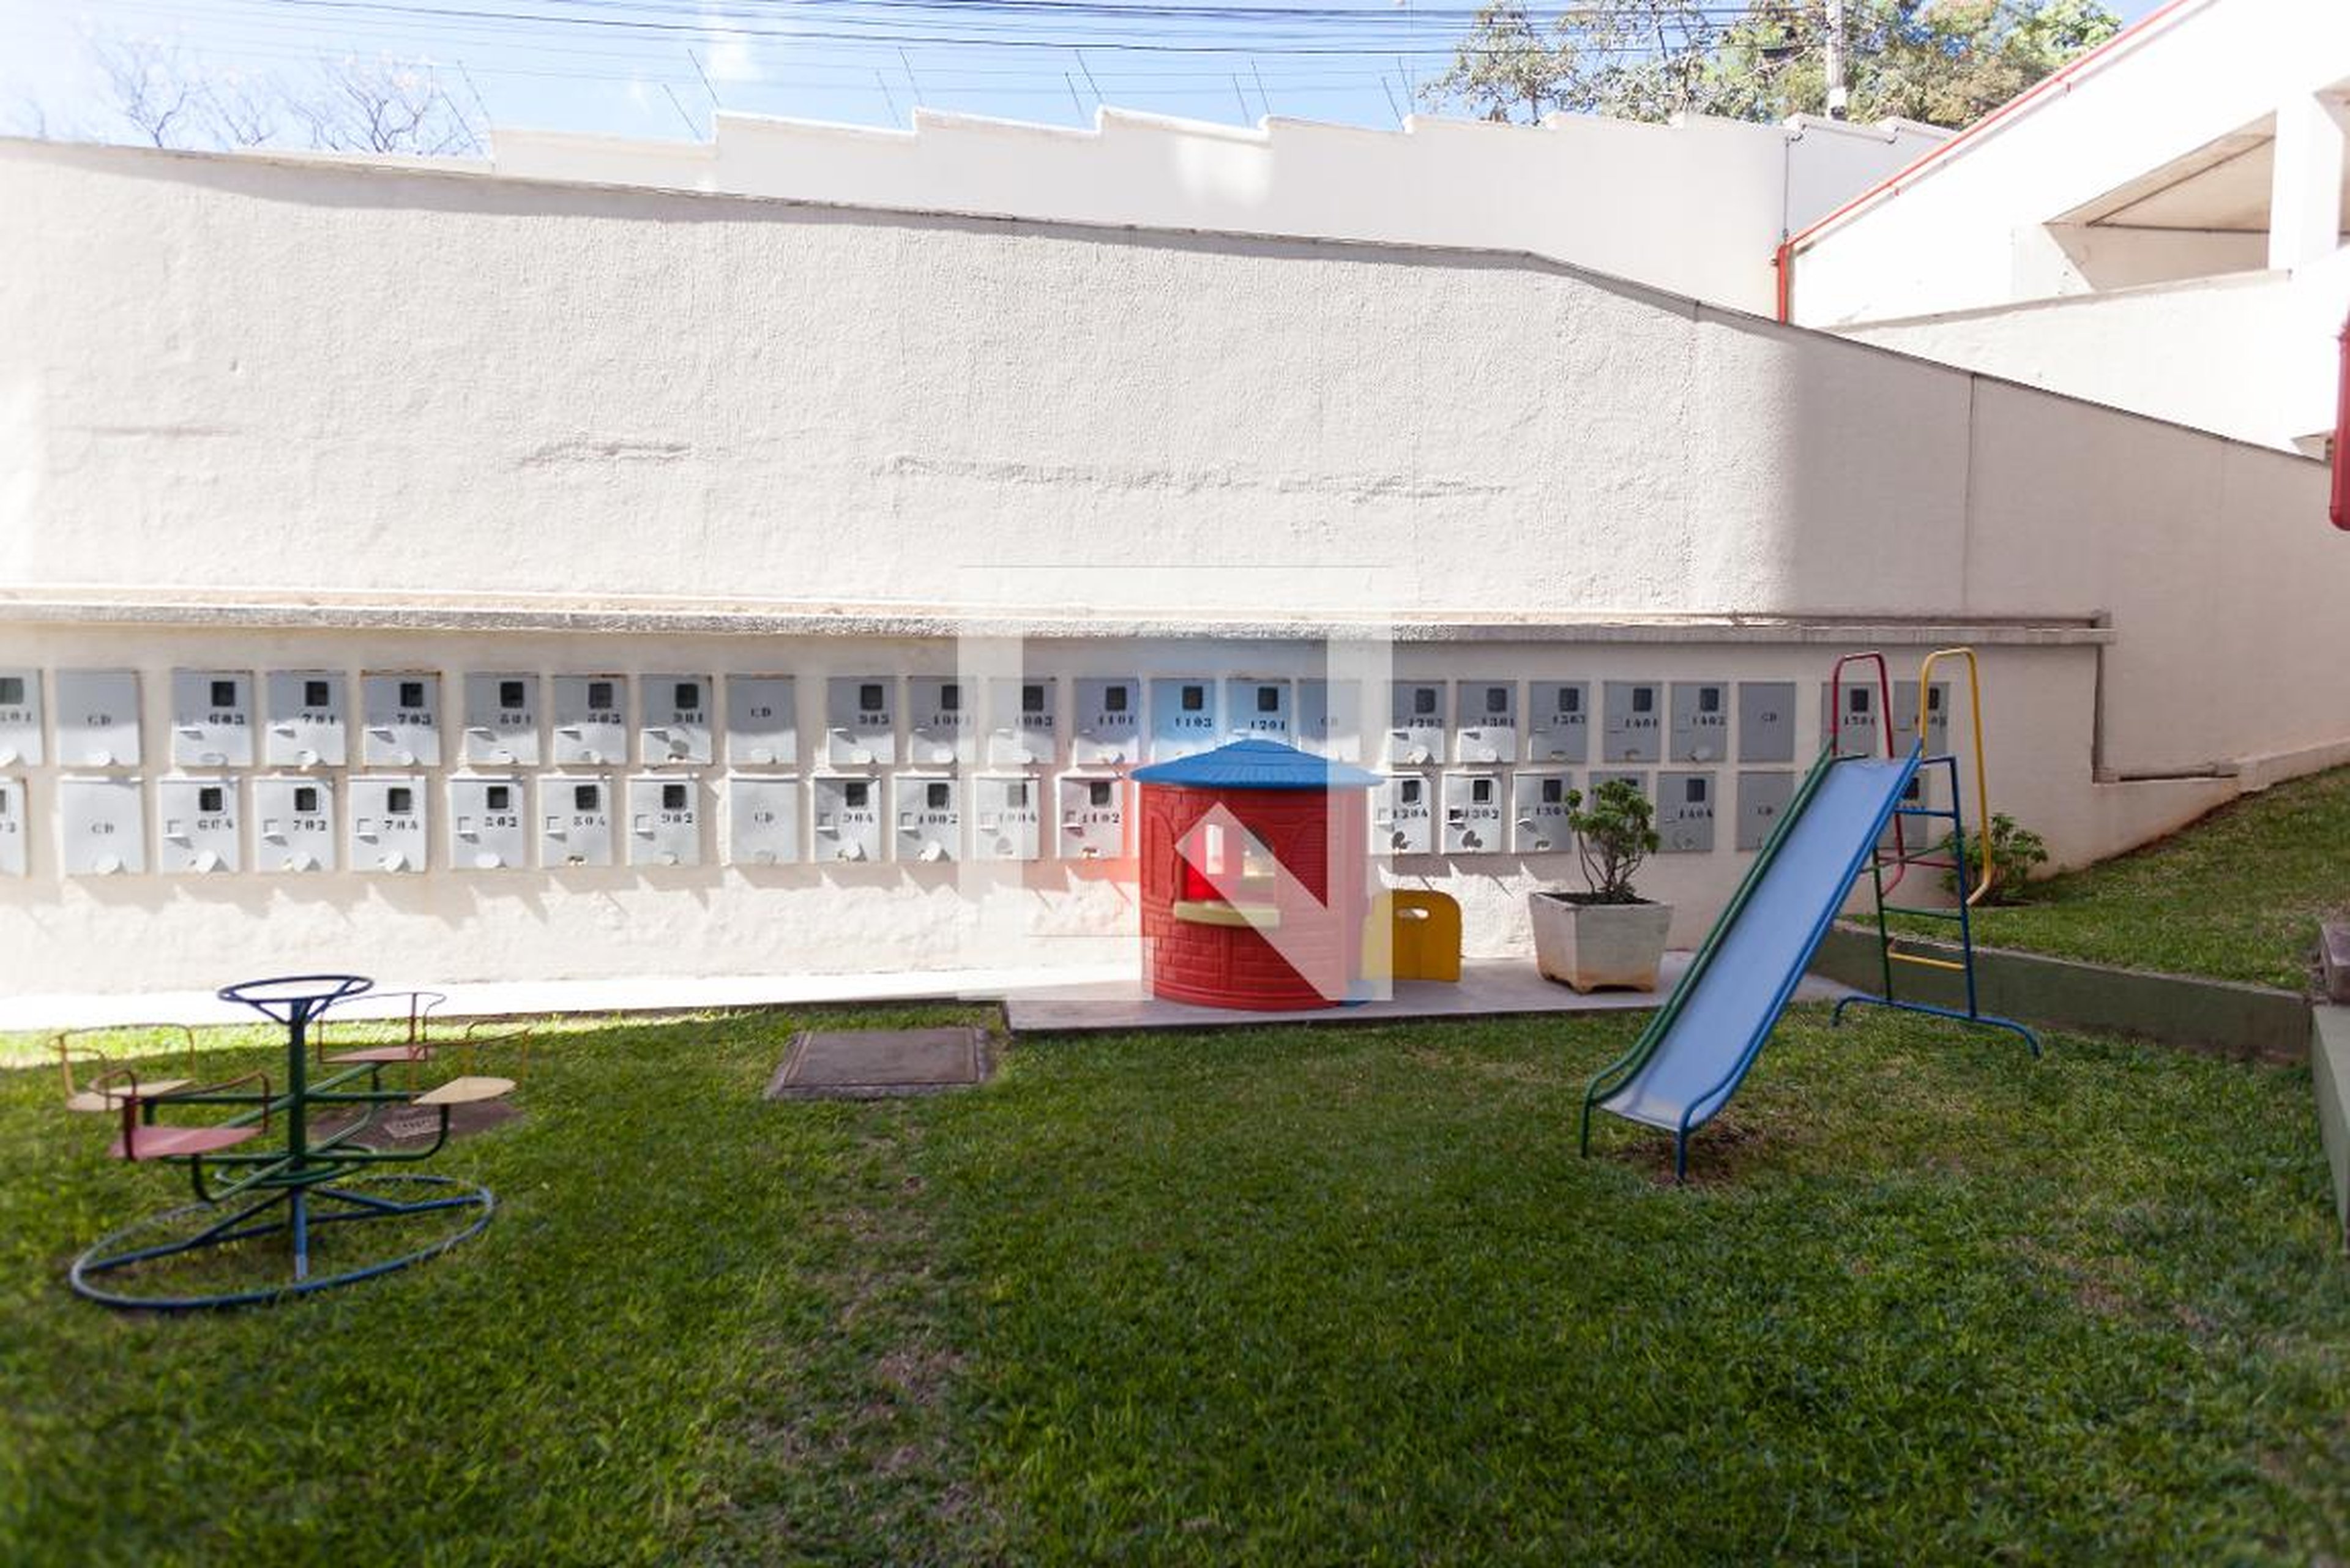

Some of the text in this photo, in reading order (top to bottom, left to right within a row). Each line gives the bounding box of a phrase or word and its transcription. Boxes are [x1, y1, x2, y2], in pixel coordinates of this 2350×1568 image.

[1098, 715, 1132, 726] 1101
[1174, 717, 1211, 728] 1103
[1249, 719, 1285, 731] 1201
[1082, 813, 1118, 824] 1102
